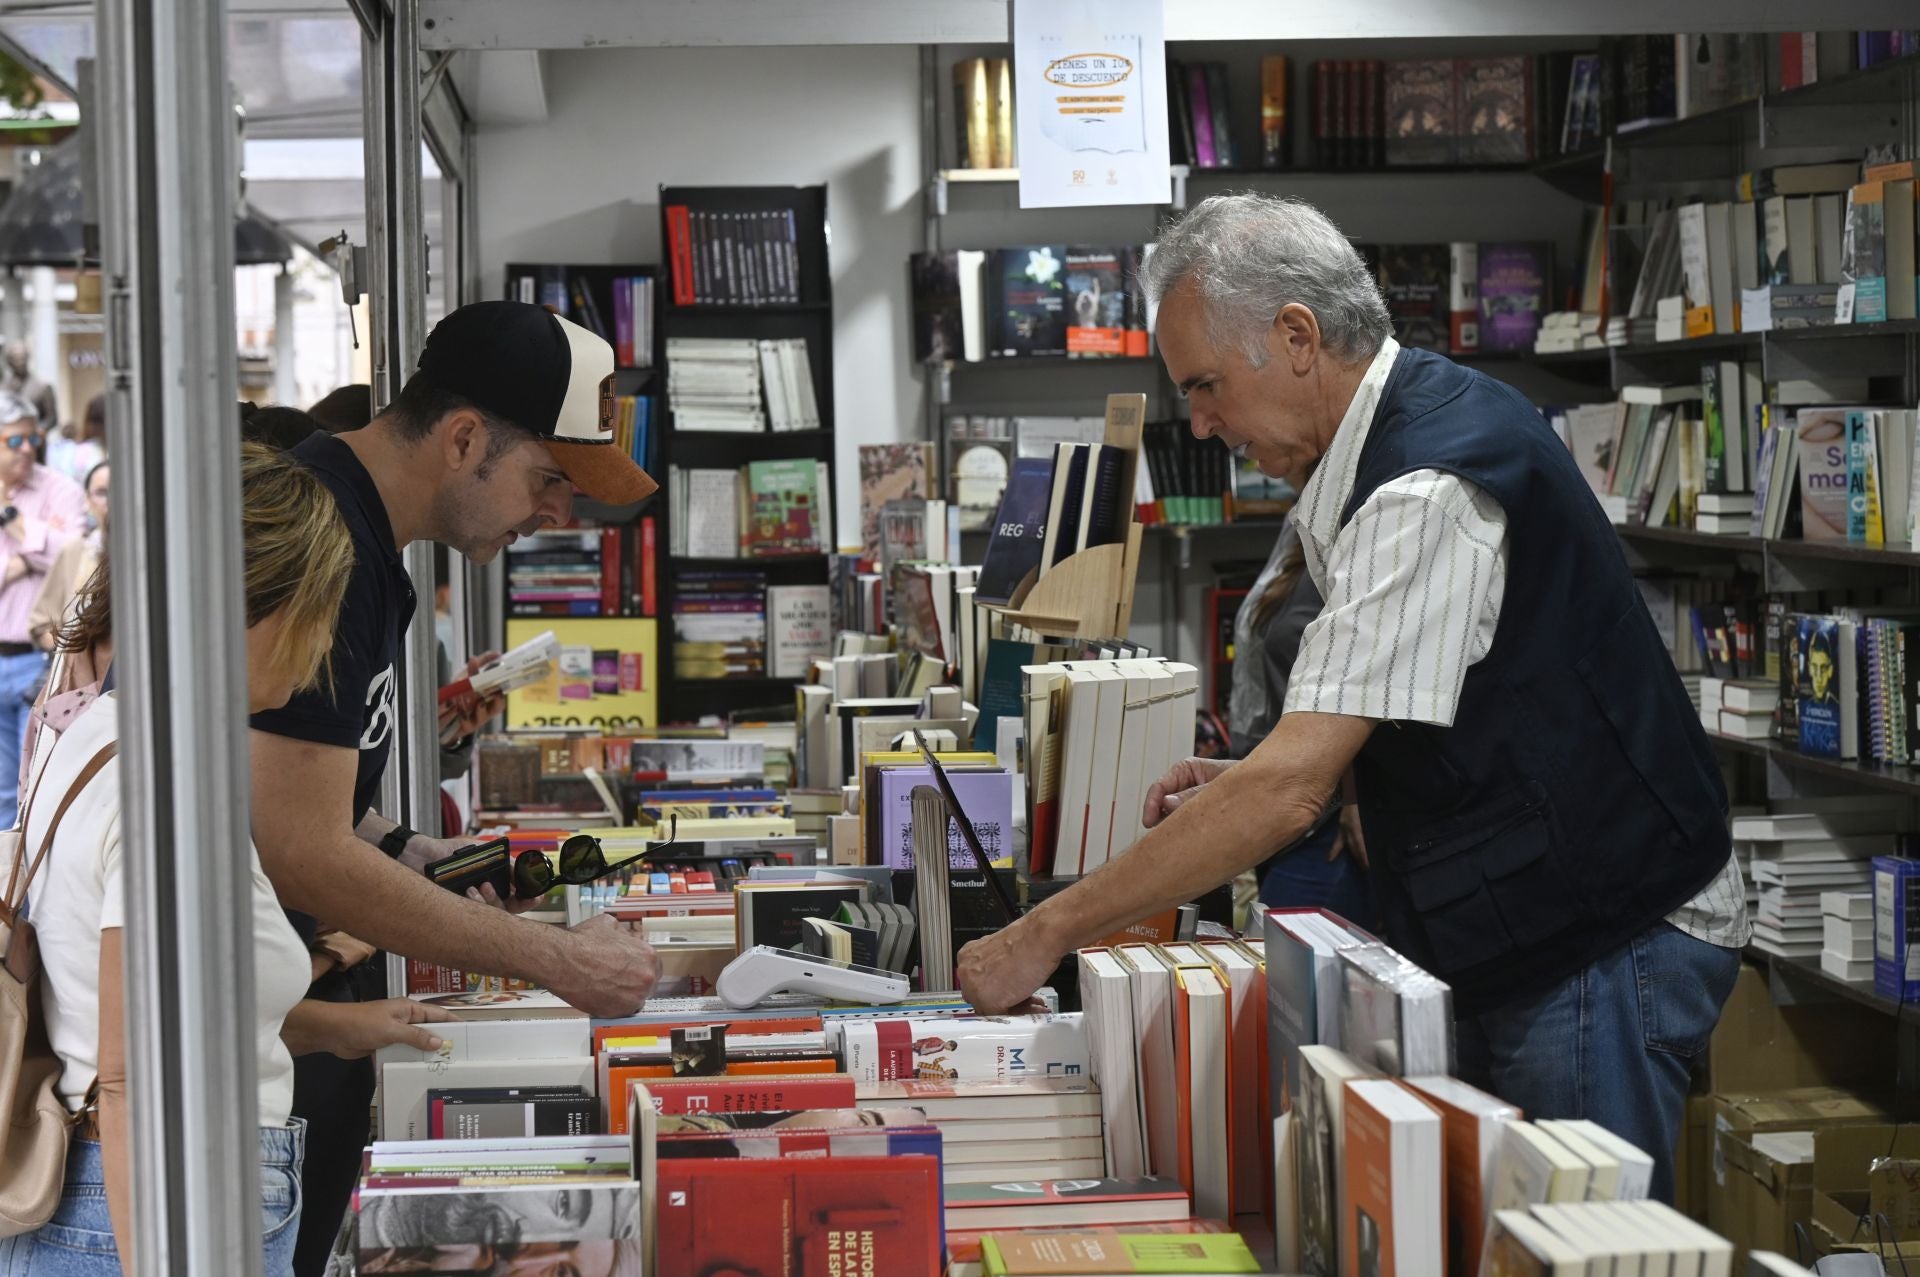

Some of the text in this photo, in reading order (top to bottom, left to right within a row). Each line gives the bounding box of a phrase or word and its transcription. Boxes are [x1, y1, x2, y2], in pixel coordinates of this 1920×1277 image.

[1049, 59, 1087, 70] TIENES
[1093, 59, 1106, 69] UN
[1053, 72, 1129, 84] DE DESCUENTO
[1827, 446, 1847, 467] S
[1808, 473, 1847, 489] ma
[451, 968, 461, 990] ERT
[723, 1094, 731, 1112] Aur
[736, 1093, 744, 1111] Mar
[749, 1093, 758, 1111] Zen
[828, 1231, 840, 1277] EN ESP
[845, 1231, 857, 1270] DE LA
